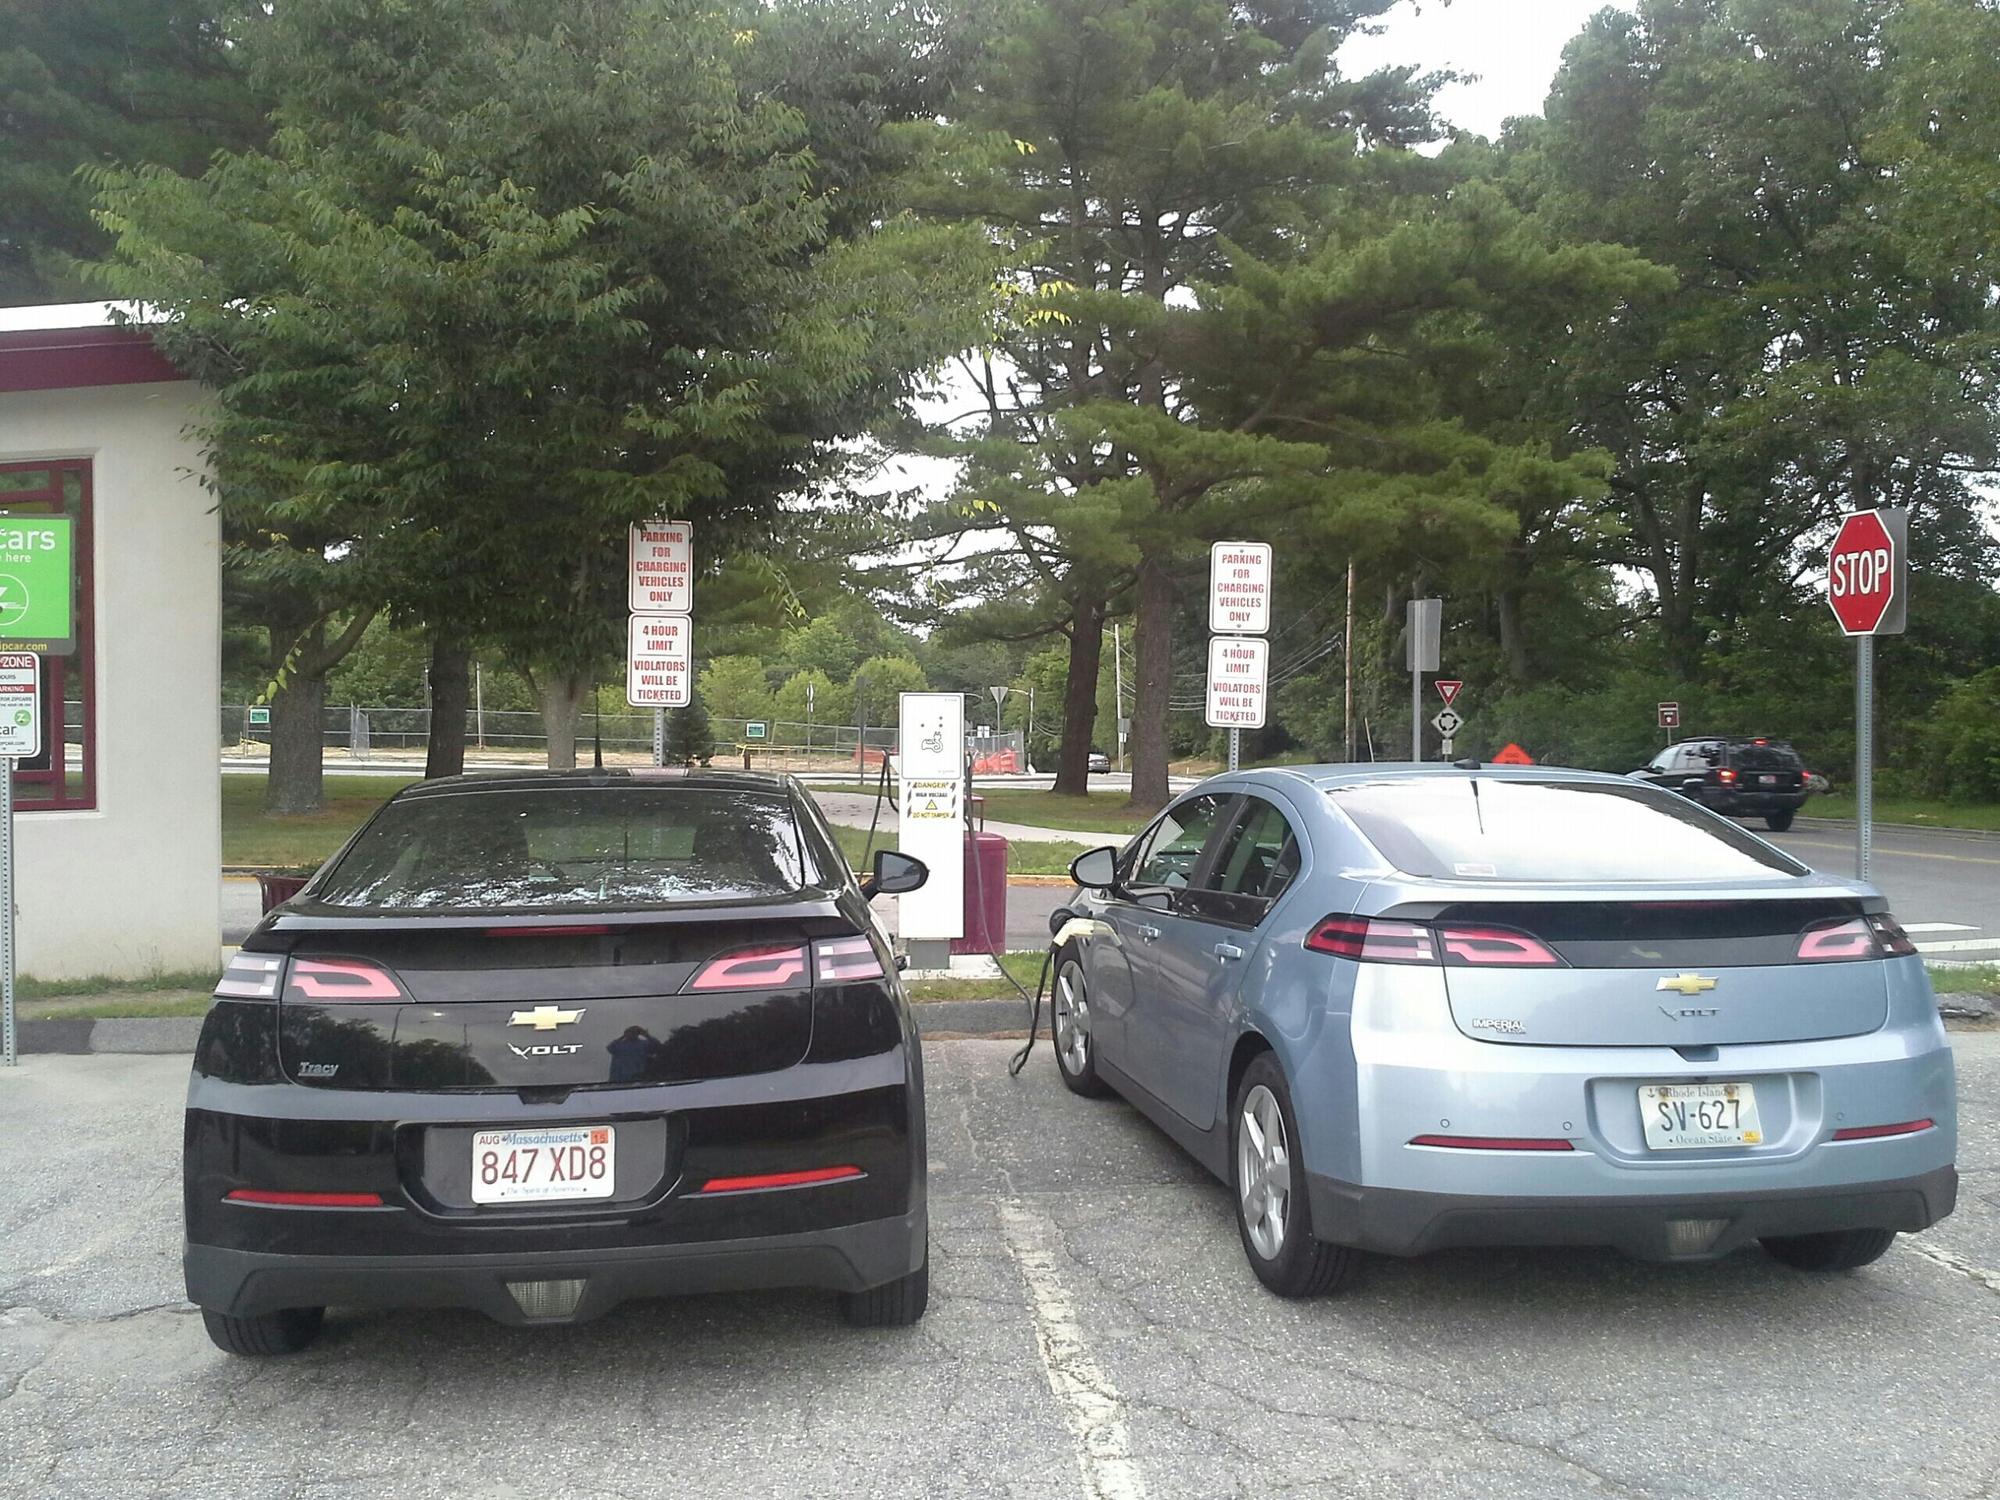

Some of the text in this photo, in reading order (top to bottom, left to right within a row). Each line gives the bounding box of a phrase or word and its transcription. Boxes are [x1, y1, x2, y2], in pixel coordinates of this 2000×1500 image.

[640, 532, 683, 543] PARKING
[6, 552, 32, 563] here
[652, 547, 671, 557] FOR
[1222, 554, 1262, 565] PARKING
[636, 561, 687, 573] CHARGING
[1233, 568, 1250, 579] FOR
[1833, 549, 1888, 598] STOP
[638, 576, 684, 588] VEHICLES
[1217, 582, 1264, 593] CHARGING
[649, 591, 673, 602] ONLY
[1219, 597, 1261, 608] VEHICLES
[1229, 611, 1251, 622] ONLY
[642, 625, 678, 636] 4 HOUR
[647, 640, 674, 651] LIMIT
[1222, 648, 1255, 659] 4 HOUR
[2, 656, 33, 668] ZONE
[634, 660, 686, 672] VIOLATORS
[1226, 663, 1250, 673] LIMIT
[641, 675, 678, 686] WILL BE
[1213, 682, 1261, 694] VIOLATORS
[637, 689, 682, 701] TICKETED
[1219, 696, 1253, 708] WILL BE
[1216, 710, 1256, 722] TICKETED
[1658, 1005, 1721, 1022] VOLT
[506, 1042, 584, 1060] VOLT
[297, 1061, 340, 1077] Tracy
[1667, 1087, 1695, 1098] Rhode
[1658, 1099, 1740, 1131] SV-627
[479, 1135, 500, 1145] AUG
[505, 1132, 583, 1146] Massachusetts
[1675, 1134, 1706, 1145] Ocean
[1708, 1134, 1733, 1144] State
[481, 1146, 606, 1185] 847 XD8
